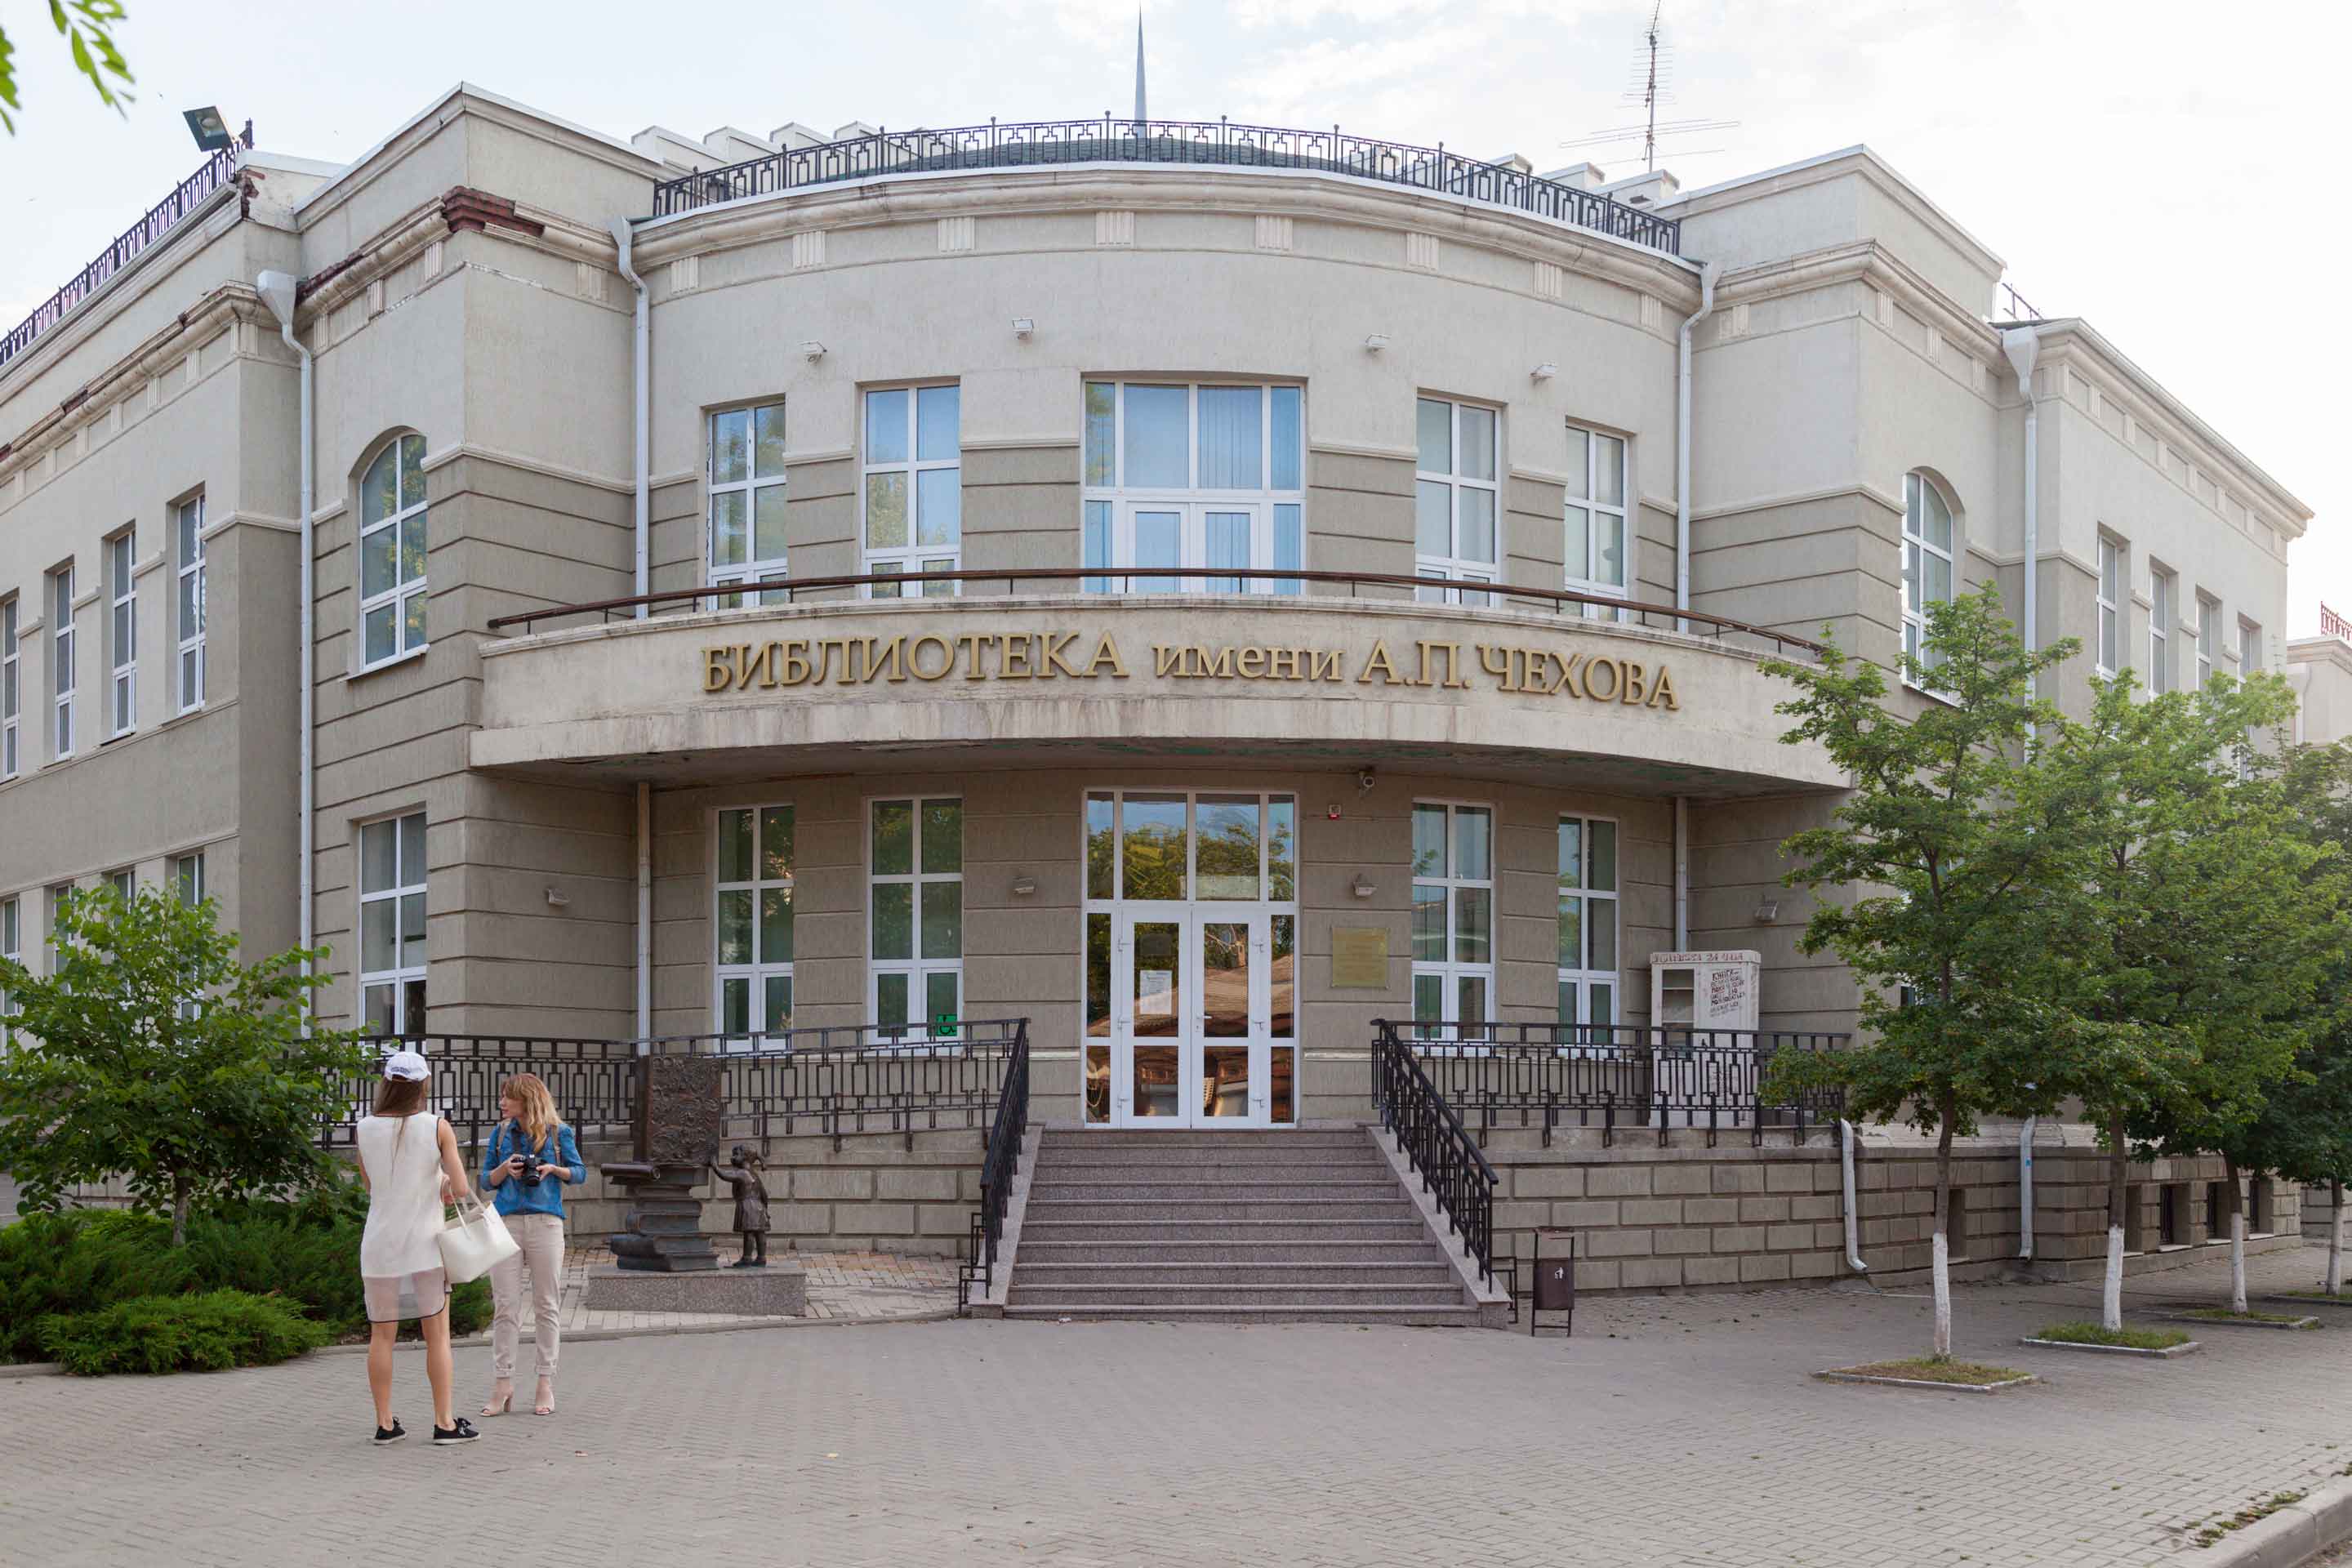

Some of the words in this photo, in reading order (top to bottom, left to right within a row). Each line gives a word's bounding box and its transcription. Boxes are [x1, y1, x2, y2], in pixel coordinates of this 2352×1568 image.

[703, 630, 1130, 692] БИБЛИОТЕКА
[1152, 642, 1343, 681] имени
[1477, 644, 1681, 711] ЧЕХОВА
